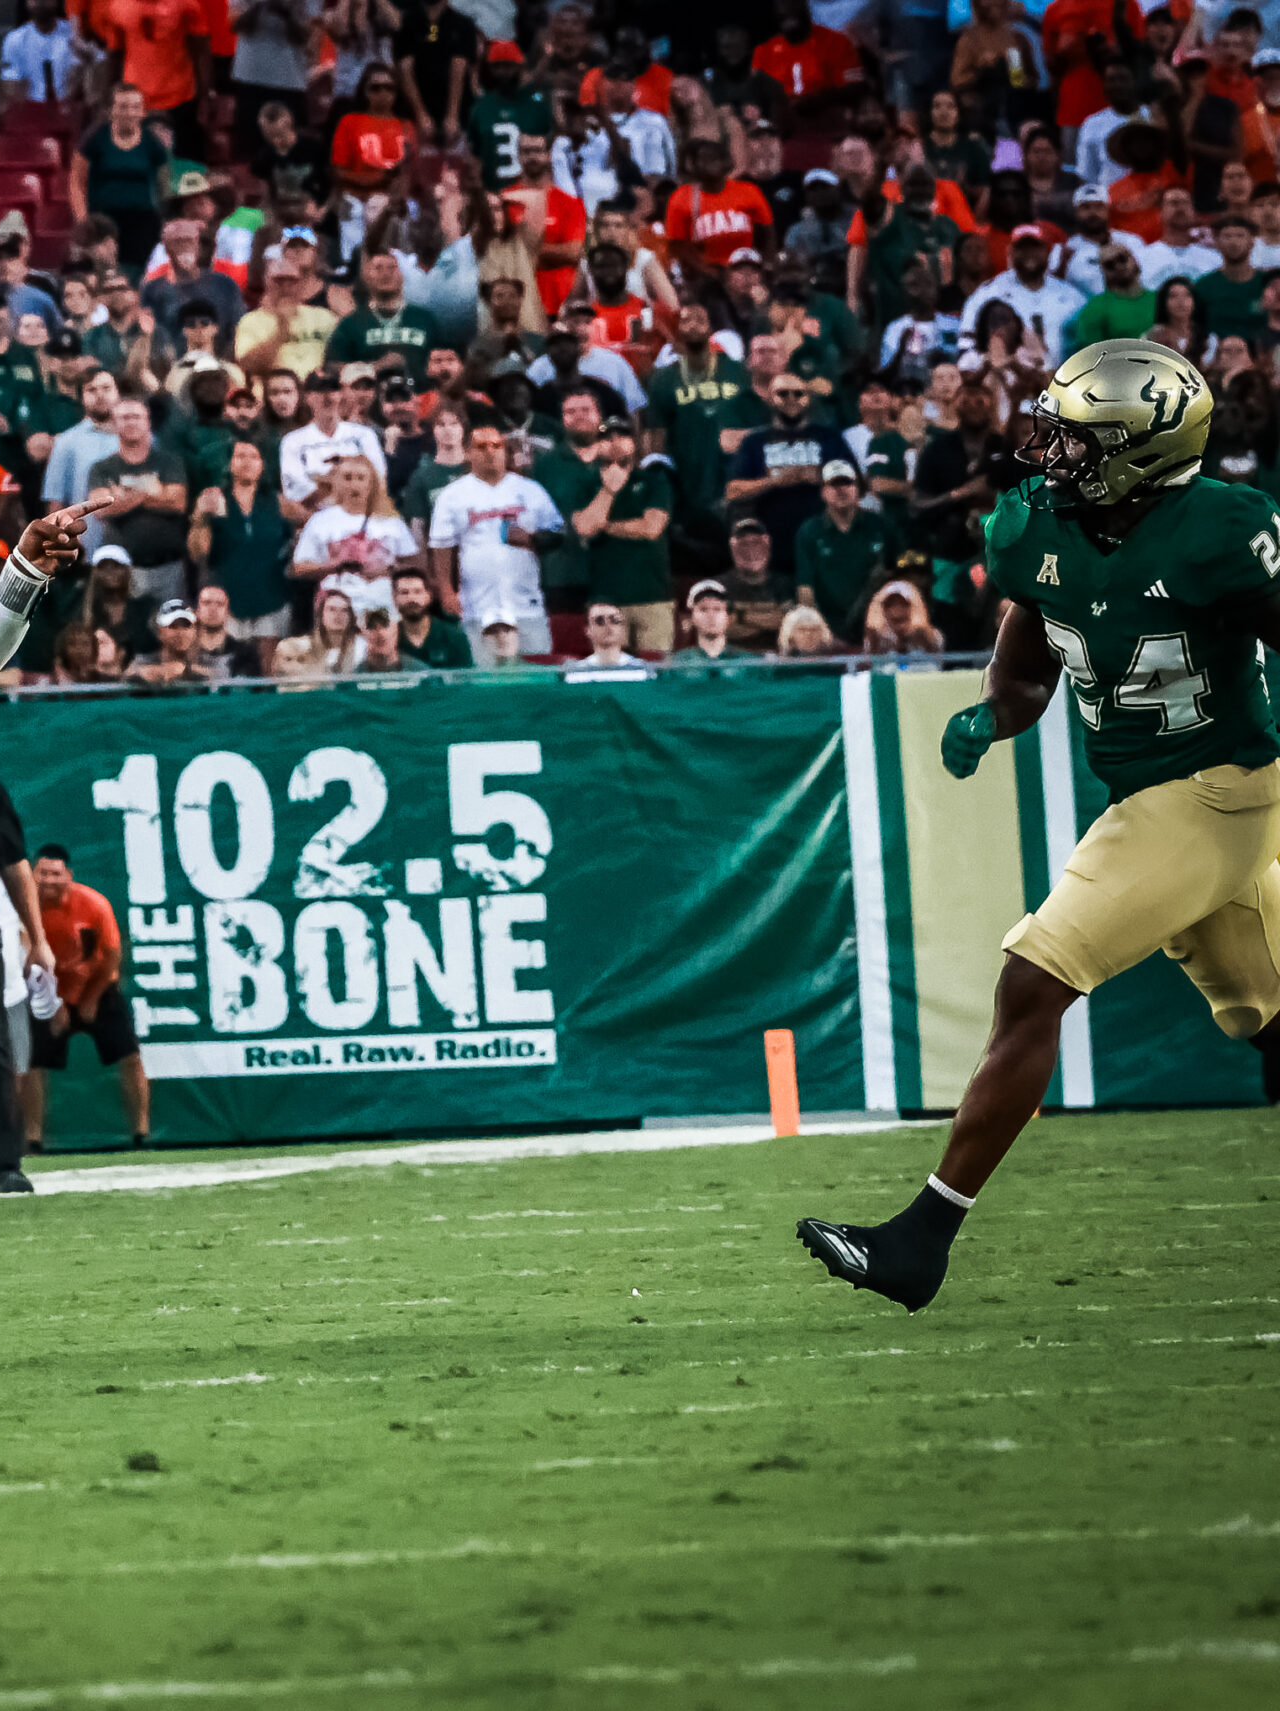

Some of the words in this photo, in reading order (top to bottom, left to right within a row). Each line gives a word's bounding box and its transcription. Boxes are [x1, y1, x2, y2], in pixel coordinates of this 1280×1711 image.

[492, 122, 522, 178] 3
[1036, 553, 1060, 586] A
[1248, 511, 1280, 579] 2
[1042, 616, 1214, 735] 24
[92, 740, 553, 905] 102.5
[128, 904, 200, 1037] THE
[203, 892, 554, 1034] BONE
[244, 1043, 331, 1069] Real.
[341, 1041, 425, 1065] Raw.
[434, 1036, 548, 1061] Radio.
